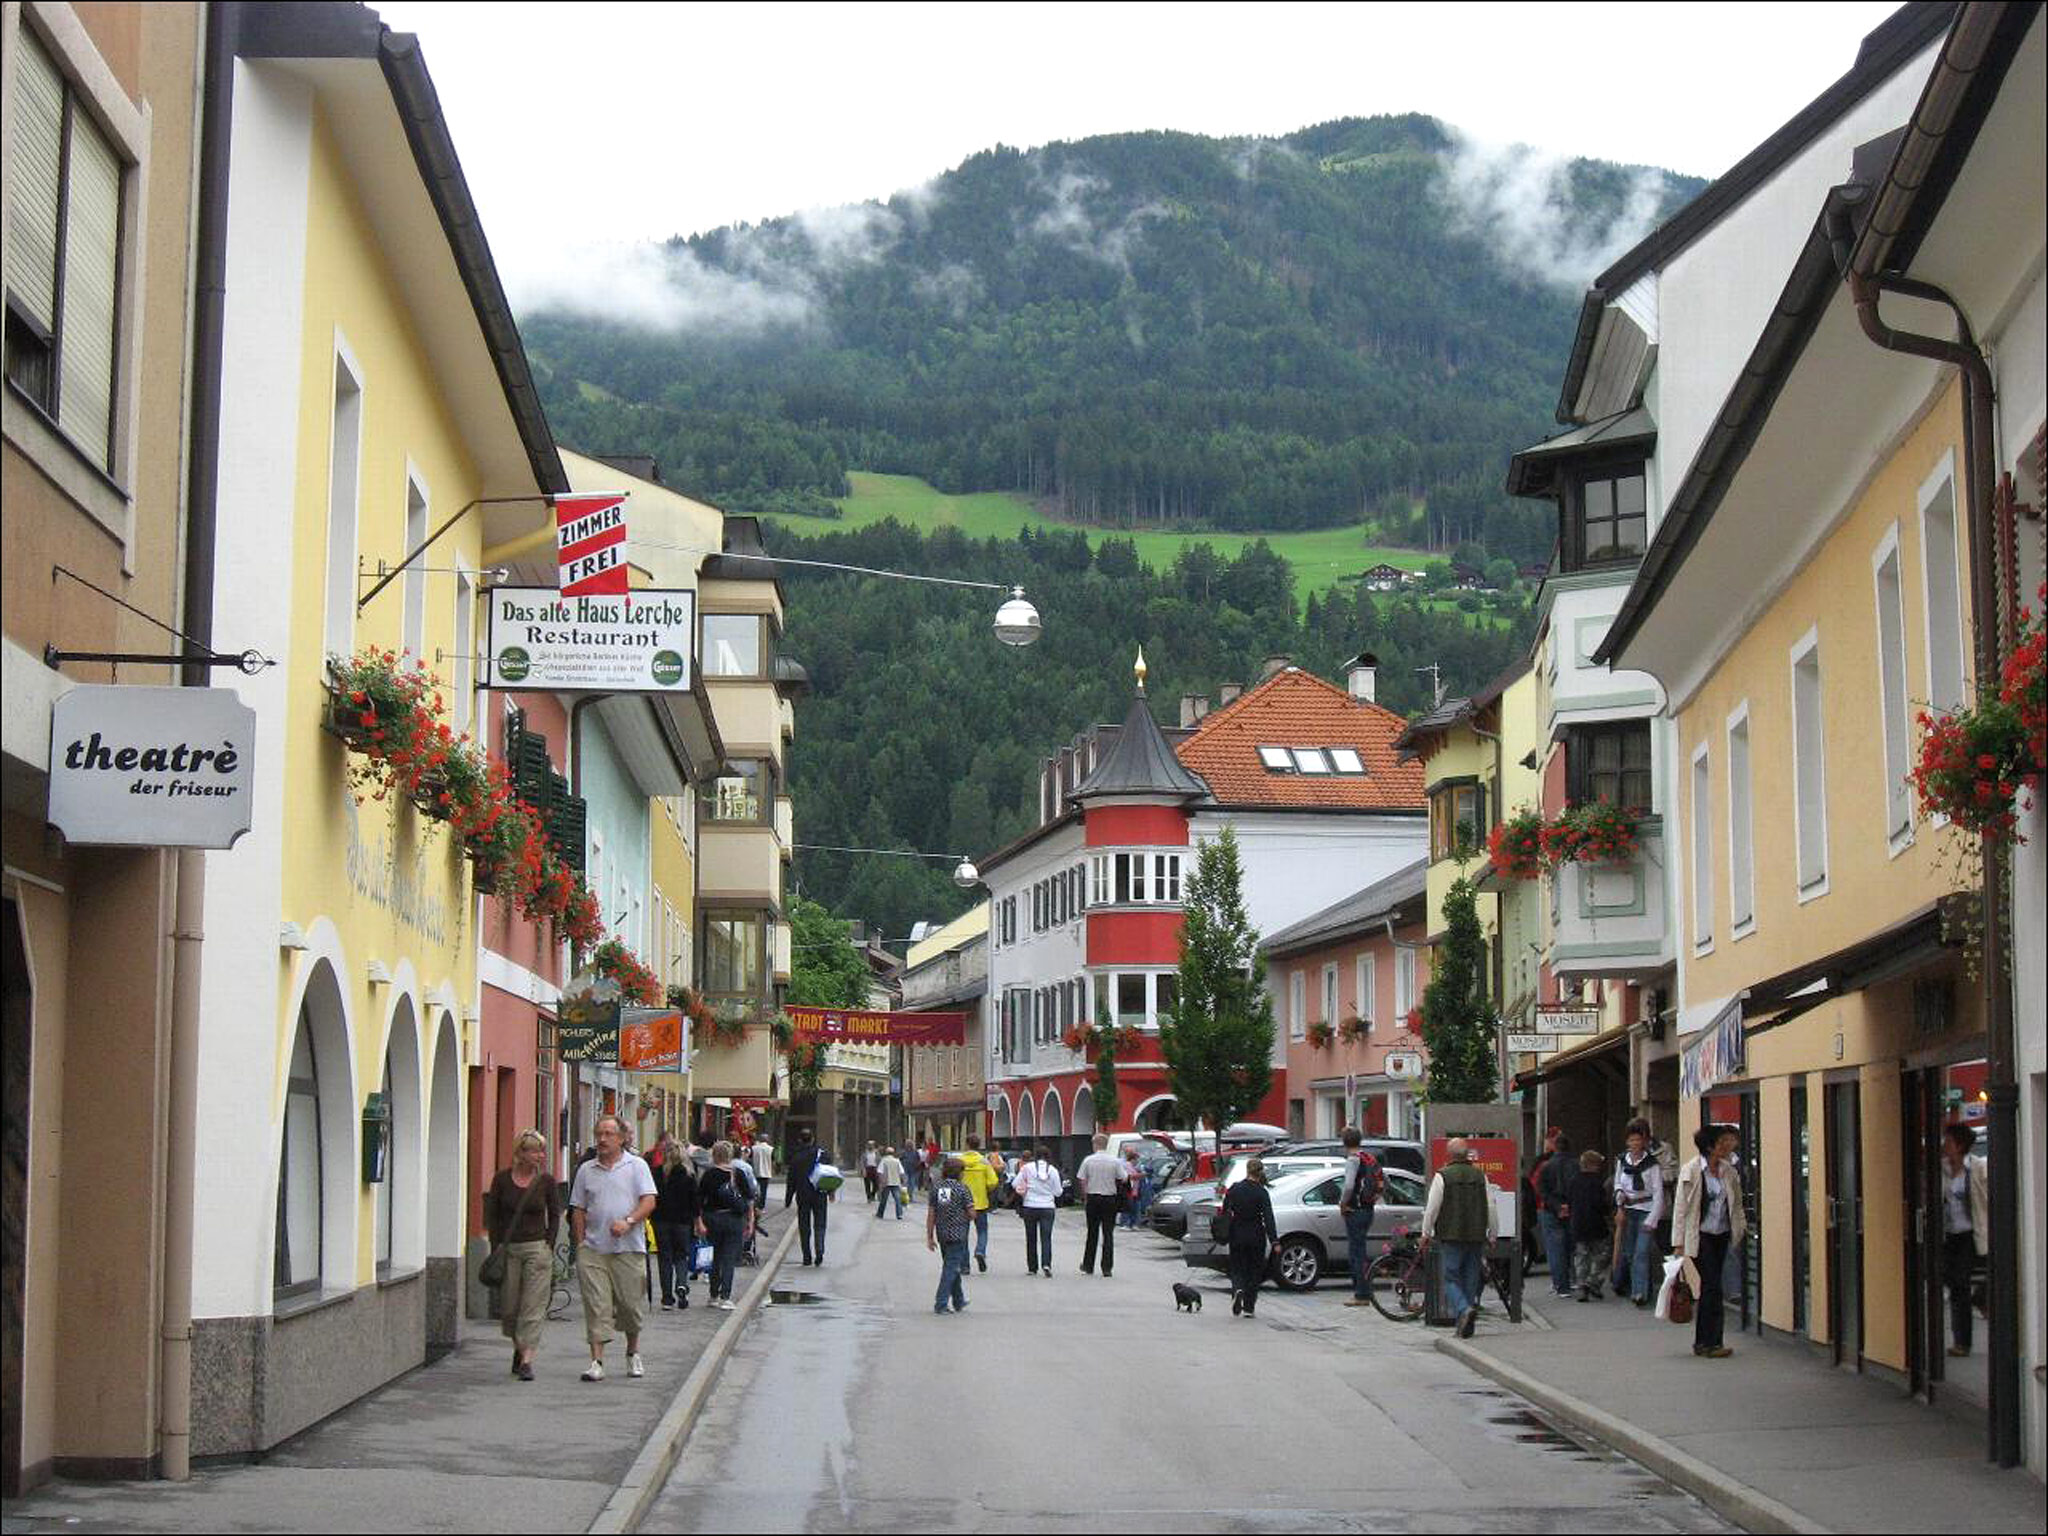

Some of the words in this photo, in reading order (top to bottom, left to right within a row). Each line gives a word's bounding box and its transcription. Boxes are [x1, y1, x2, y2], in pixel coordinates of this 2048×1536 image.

[560, 506, 622, 547] ZIMMER
[568, 547, 618, 583] FREI
[503, 601, 535, 622] Das
[540, 602, 571, 622] alte
[577, 597, 619, 622] Haus
[624, 599, 683, 628] Lerche
[526, 626, 660, 648] Restaurant
[66, 732, 238, 774] theatrè
[129, 779, 163, 795] der
[167, 780, 238, 798] friseur
[792, 1013, 823, 1031] STADT
[848, 1018, 890, 1034] MARKT
